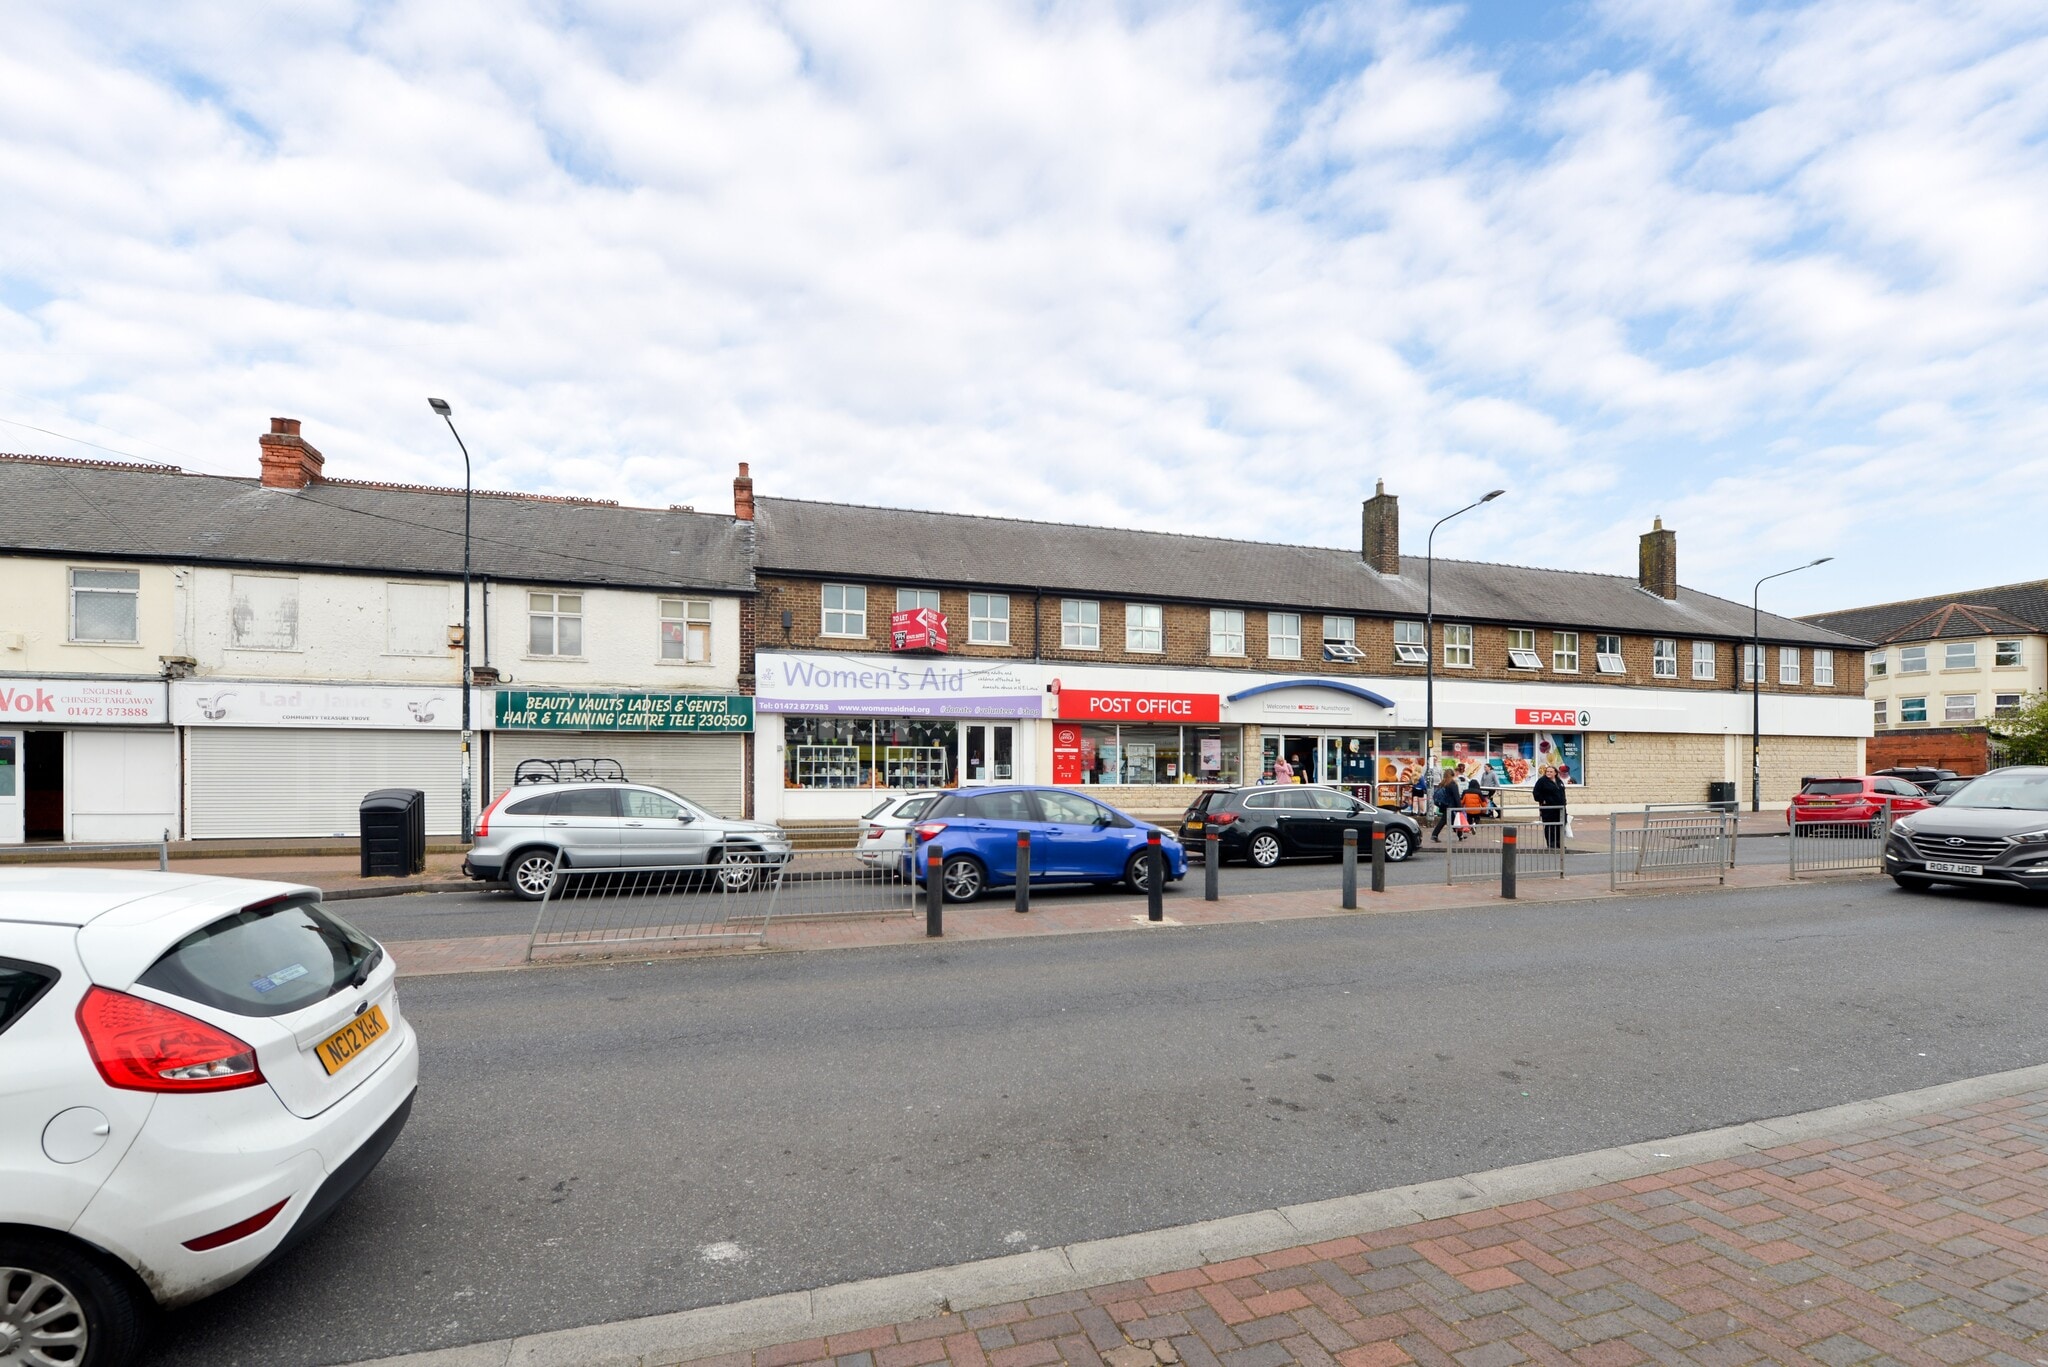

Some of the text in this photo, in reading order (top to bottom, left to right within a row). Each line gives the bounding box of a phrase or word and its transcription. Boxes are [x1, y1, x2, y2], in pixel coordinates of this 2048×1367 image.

[783, 661, 962, 691] Women's Aid
[82, 687, 122, 696] ENGLISH
[61, 696, 154, 705] CHINESE TAKEAWAY
[526, 697, 726, 713] BEAUTY VAULTS LADIES & GENTS
[759, 702, 829, 711] Tel: 01472 877583
[1090, 697, 1192, 715] POST OFFICE
[68, 707, 148, 717] 01472 873888
[838, 705, 930, 714] www.womensaidnel.org
[1321, 704, 1350, 712] Nunsthorpe
[502, 711, 747, 727] HAIR & TANNING CENTRE TELE 230550
[1529, 711, 1575, 724] SPAR
[1930, 862, 1978, 874] RO67 HDE
[326, 1011, 383, 1066] NC12 XLK
